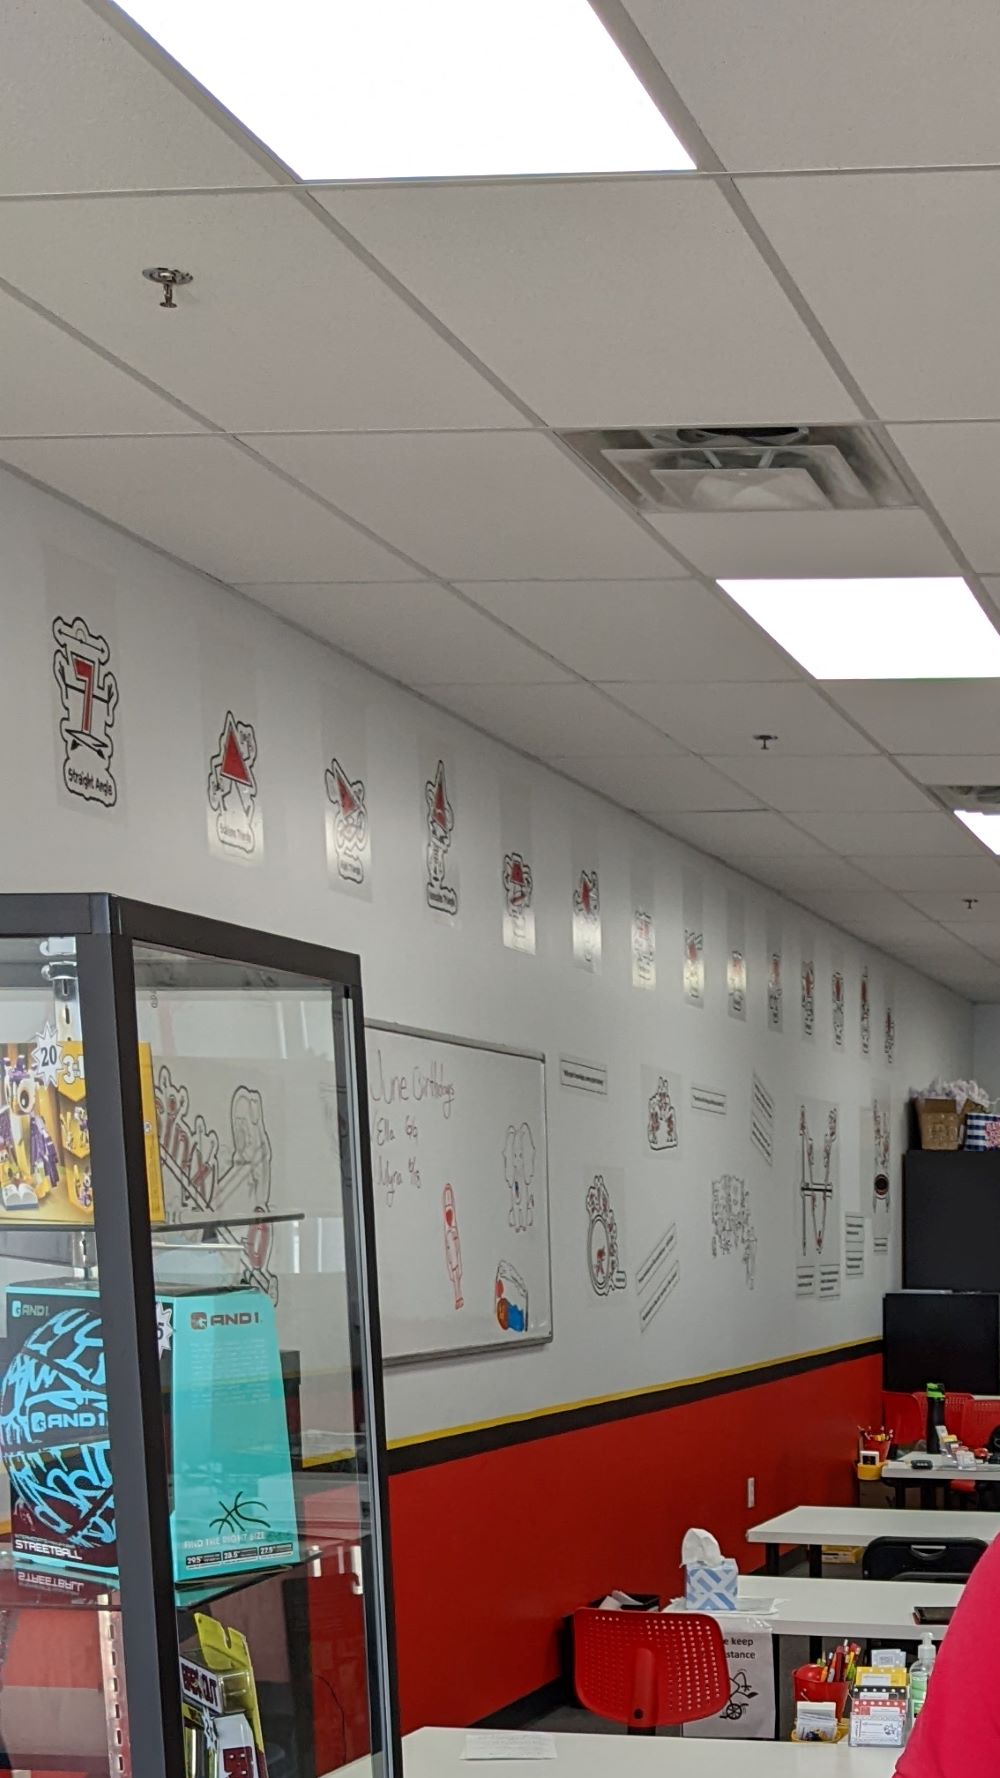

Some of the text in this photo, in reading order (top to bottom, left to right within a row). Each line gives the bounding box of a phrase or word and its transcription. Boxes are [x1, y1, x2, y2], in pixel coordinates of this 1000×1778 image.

[68, 768, 95, 790] Straight
[41, 1044, 57, 1067] 20
[371, 1050, 409, 1104] June
[15, 1539, 83, 1560] STREETBALL
[731, 1637, 754, 1647] keep
[726, 1650, 756, 1660] stance
